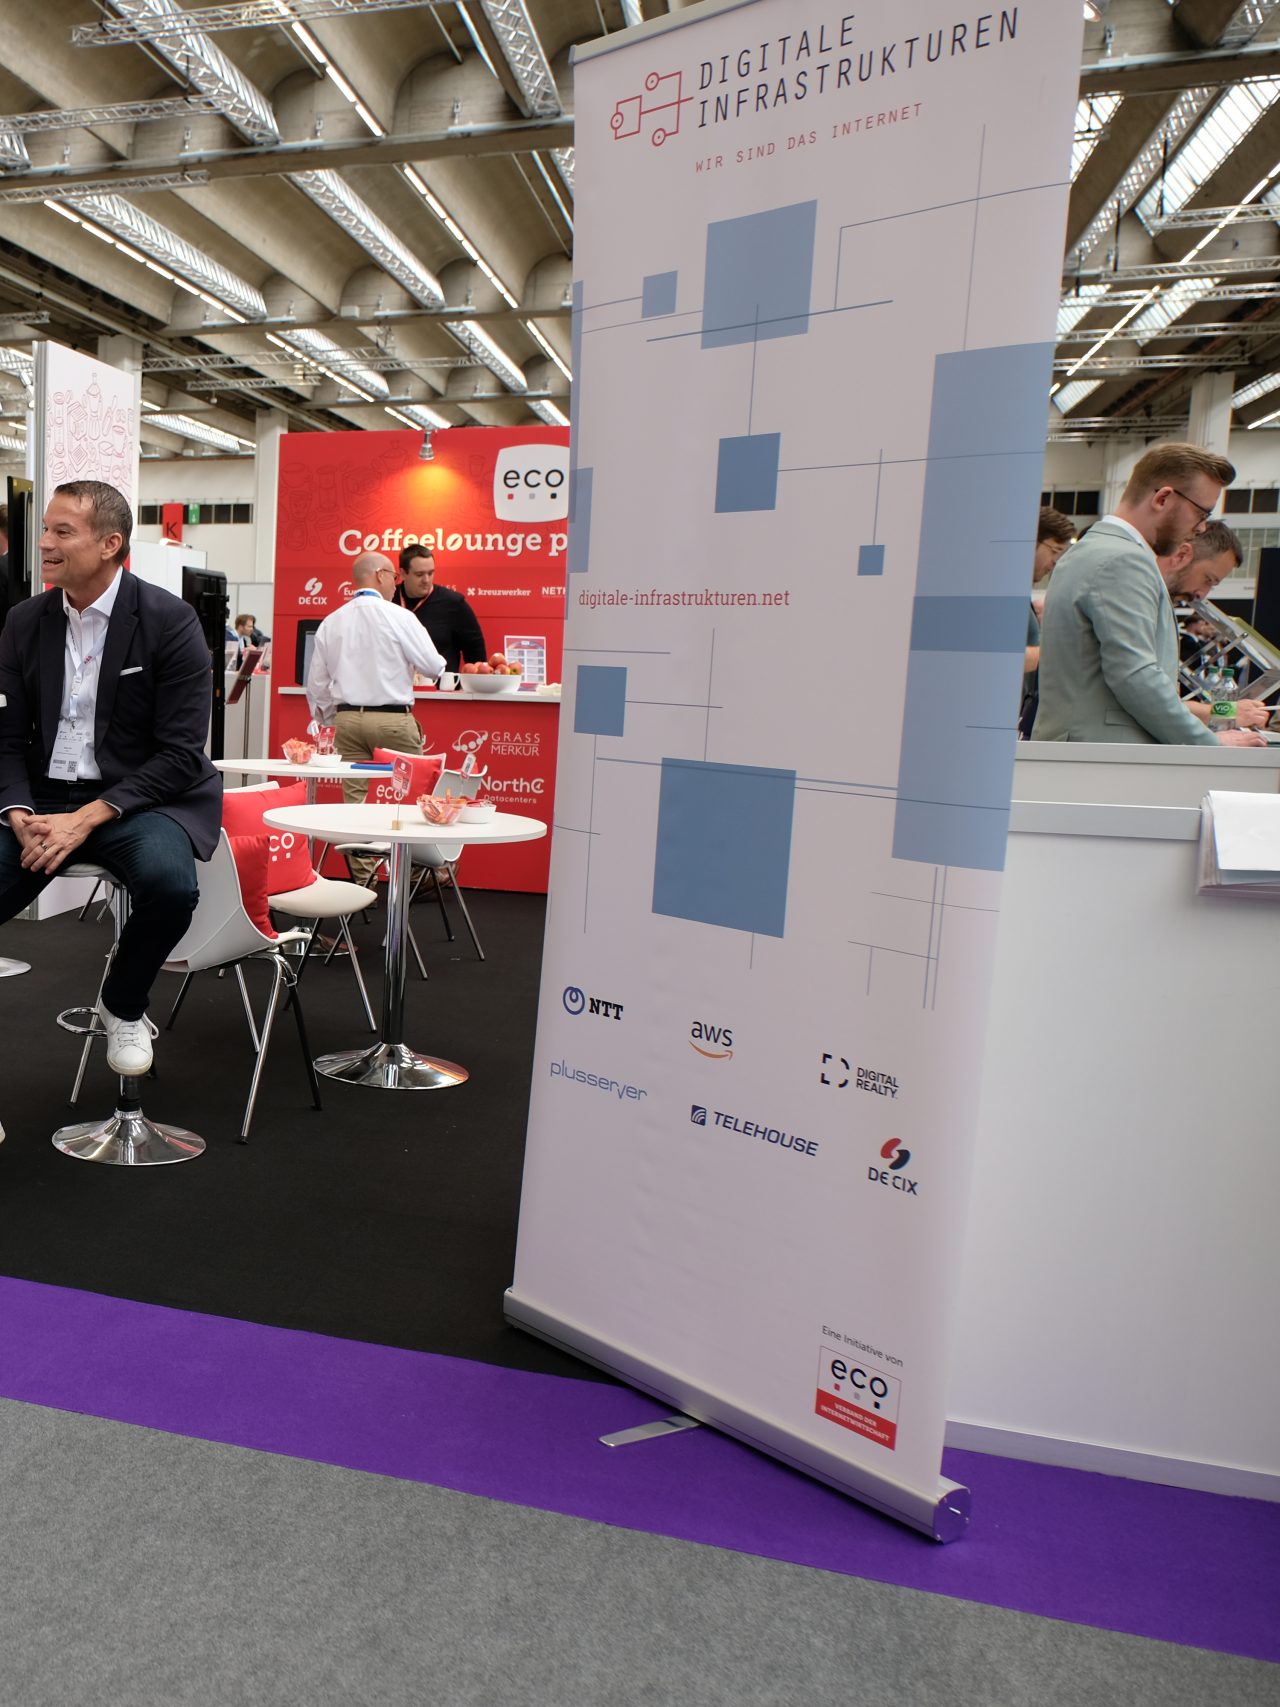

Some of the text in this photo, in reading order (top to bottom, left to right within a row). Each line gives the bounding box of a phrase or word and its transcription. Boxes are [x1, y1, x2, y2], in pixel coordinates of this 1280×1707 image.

[699, 15, 855, 91] DIGITALE
[698, 7, 1019, 129] INFRASTRUKTUREN
[695, 103, 923, 174] WIR SIND DAS INTERNET
[503, 469, 565, 489] eco
[166, 521, 178, 538] K
[338, 528, 542, 557] Coffeelounge
[298, 596, 327, 605] DE CIX
[478, 587, 532, 596] kreuzwerker
[578, 589, 791, 609] digitale-infrastrukturen.net
[491, 731, 541, 743] GRASS
[490, 744, 540, 756] MERKUR
[376, 784, 404, 801] eco
[479, 776, 545, 794] NorthC
[484, 794, 537, 804] Datacenters
[269, 832, 295, 852] co
[588, 997, 624, 1020] NTT
[690, 1021, 733, 1047] aws
[550, 1060, 648, 1101] plusserver
[856, 1066, 899, 1088] DIGITAL
[856, 1078, 898, 1099] REALTY
[713, 1111, 819, 1157] TELEHOUSE
[868, 1166, 918, 1196] DE CIX
[822, 1325, 904, 1367] Eine Initiative von
[831, 1359, 888, 1398] eco
